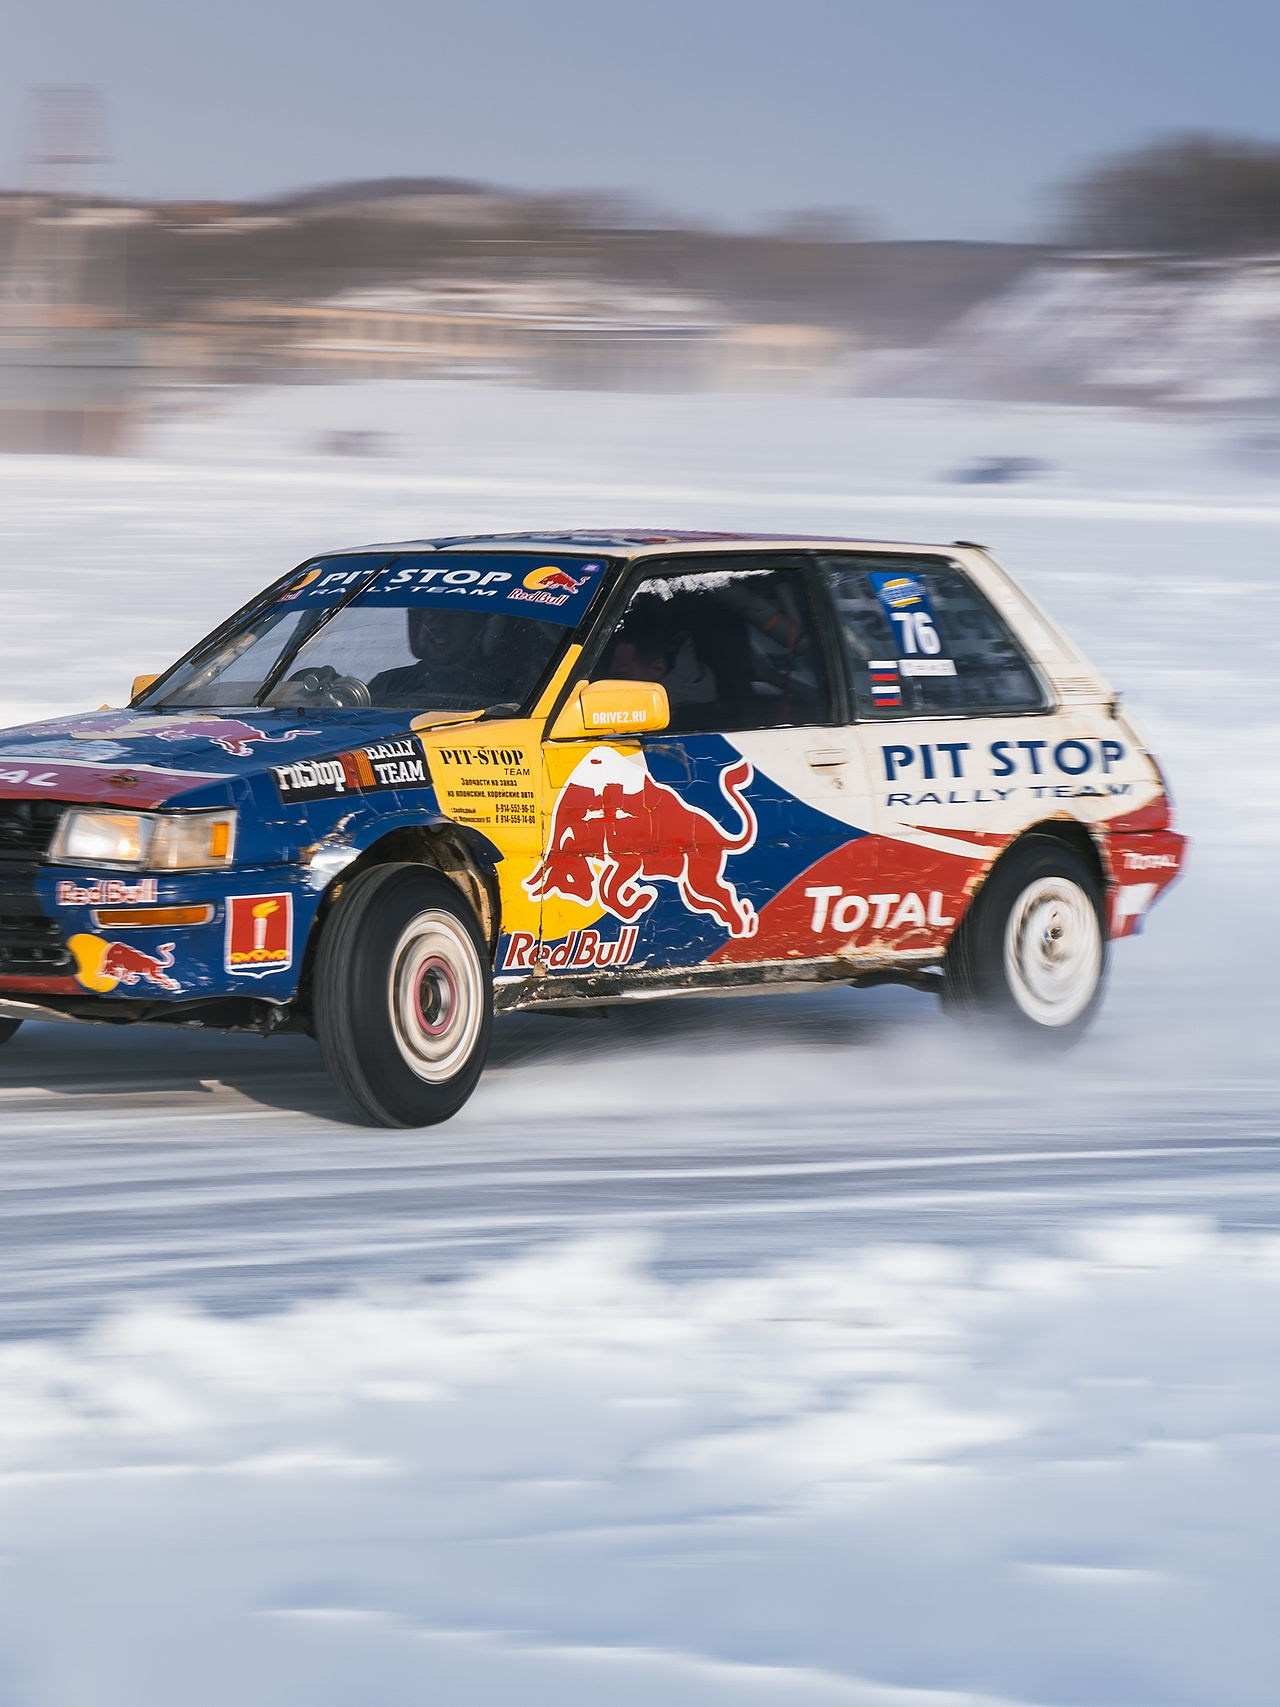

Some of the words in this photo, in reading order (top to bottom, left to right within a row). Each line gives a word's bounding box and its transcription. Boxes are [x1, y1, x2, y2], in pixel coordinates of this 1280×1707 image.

[317, 569, 390, 587] PIT
[389, 569, 512, 586] STOP
[410, 586, 498, 597] TEAM
[507, 588, 540, 602] Red
[536, 591, 570, 607] Bull
[890, 612, 942, 655] 76
[592, 710, 647, 724] DRIVE2.RU
[361, 740, 416, 760] RALLY
[439, 749, 524, 766] PIT-STOP
[881, 743, 971, 781] PIT
[989, 740, 1125, 777] STOP
[374, 760, 426, 785] TEAM
[504, 768, 531, 776] TEAM
[461, 778, 490, 786] Запчасти
[500, 779, 518, 787] заказ
[487, 790, 520, 799] корейские
[886, 788, 1016, 807] RALLY
[1027, 784, 1134, 799] TEAM
[804, 886, 956, 934] TOTAL
[502, 929, 577, 970] Red
[570, 925, 640, 968] Bull
